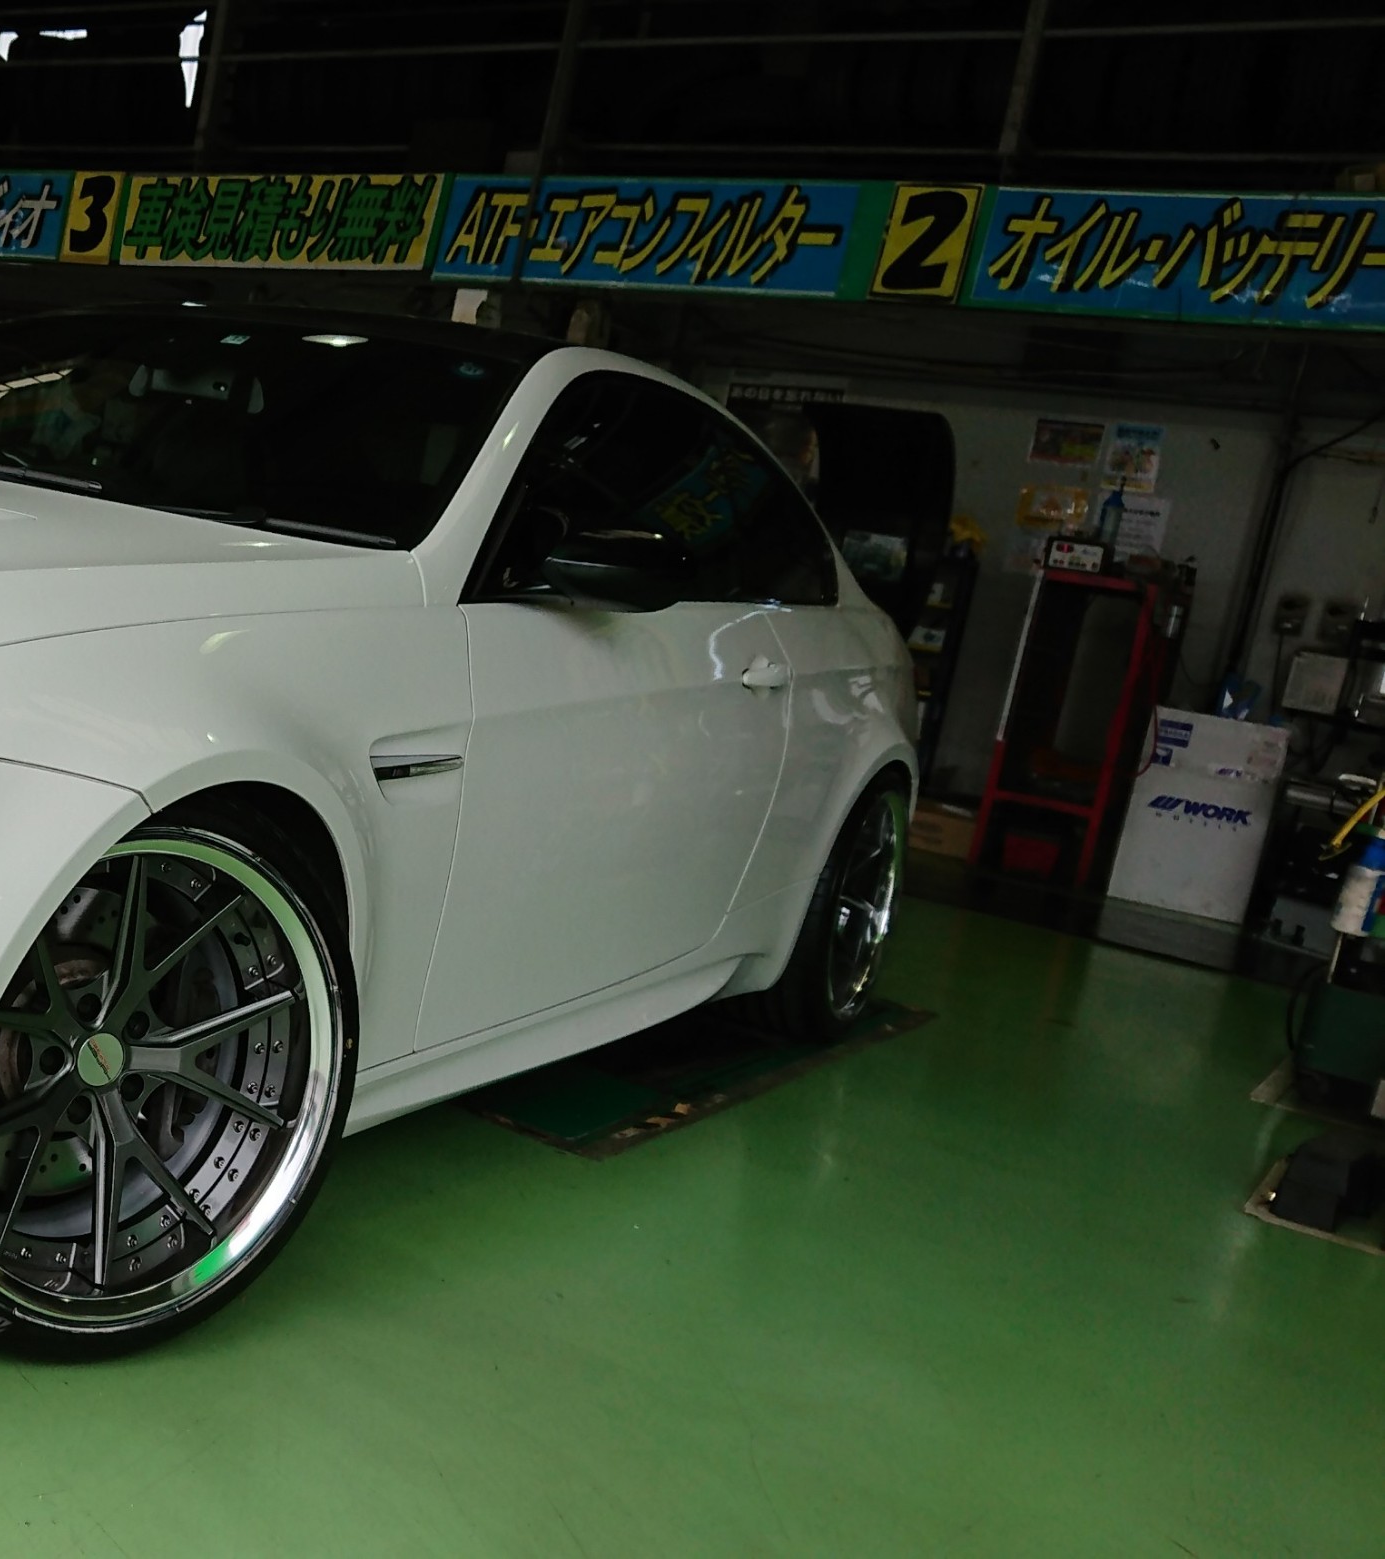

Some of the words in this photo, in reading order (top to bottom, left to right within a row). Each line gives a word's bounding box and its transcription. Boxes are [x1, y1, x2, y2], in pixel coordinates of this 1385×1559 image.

[69, 176, 116, 253] 3
[124, 175, 434, 264] 車検見積もり無料
[881, 190, 968, 290] 2
[1183, 799, 1252, 825] WORK
